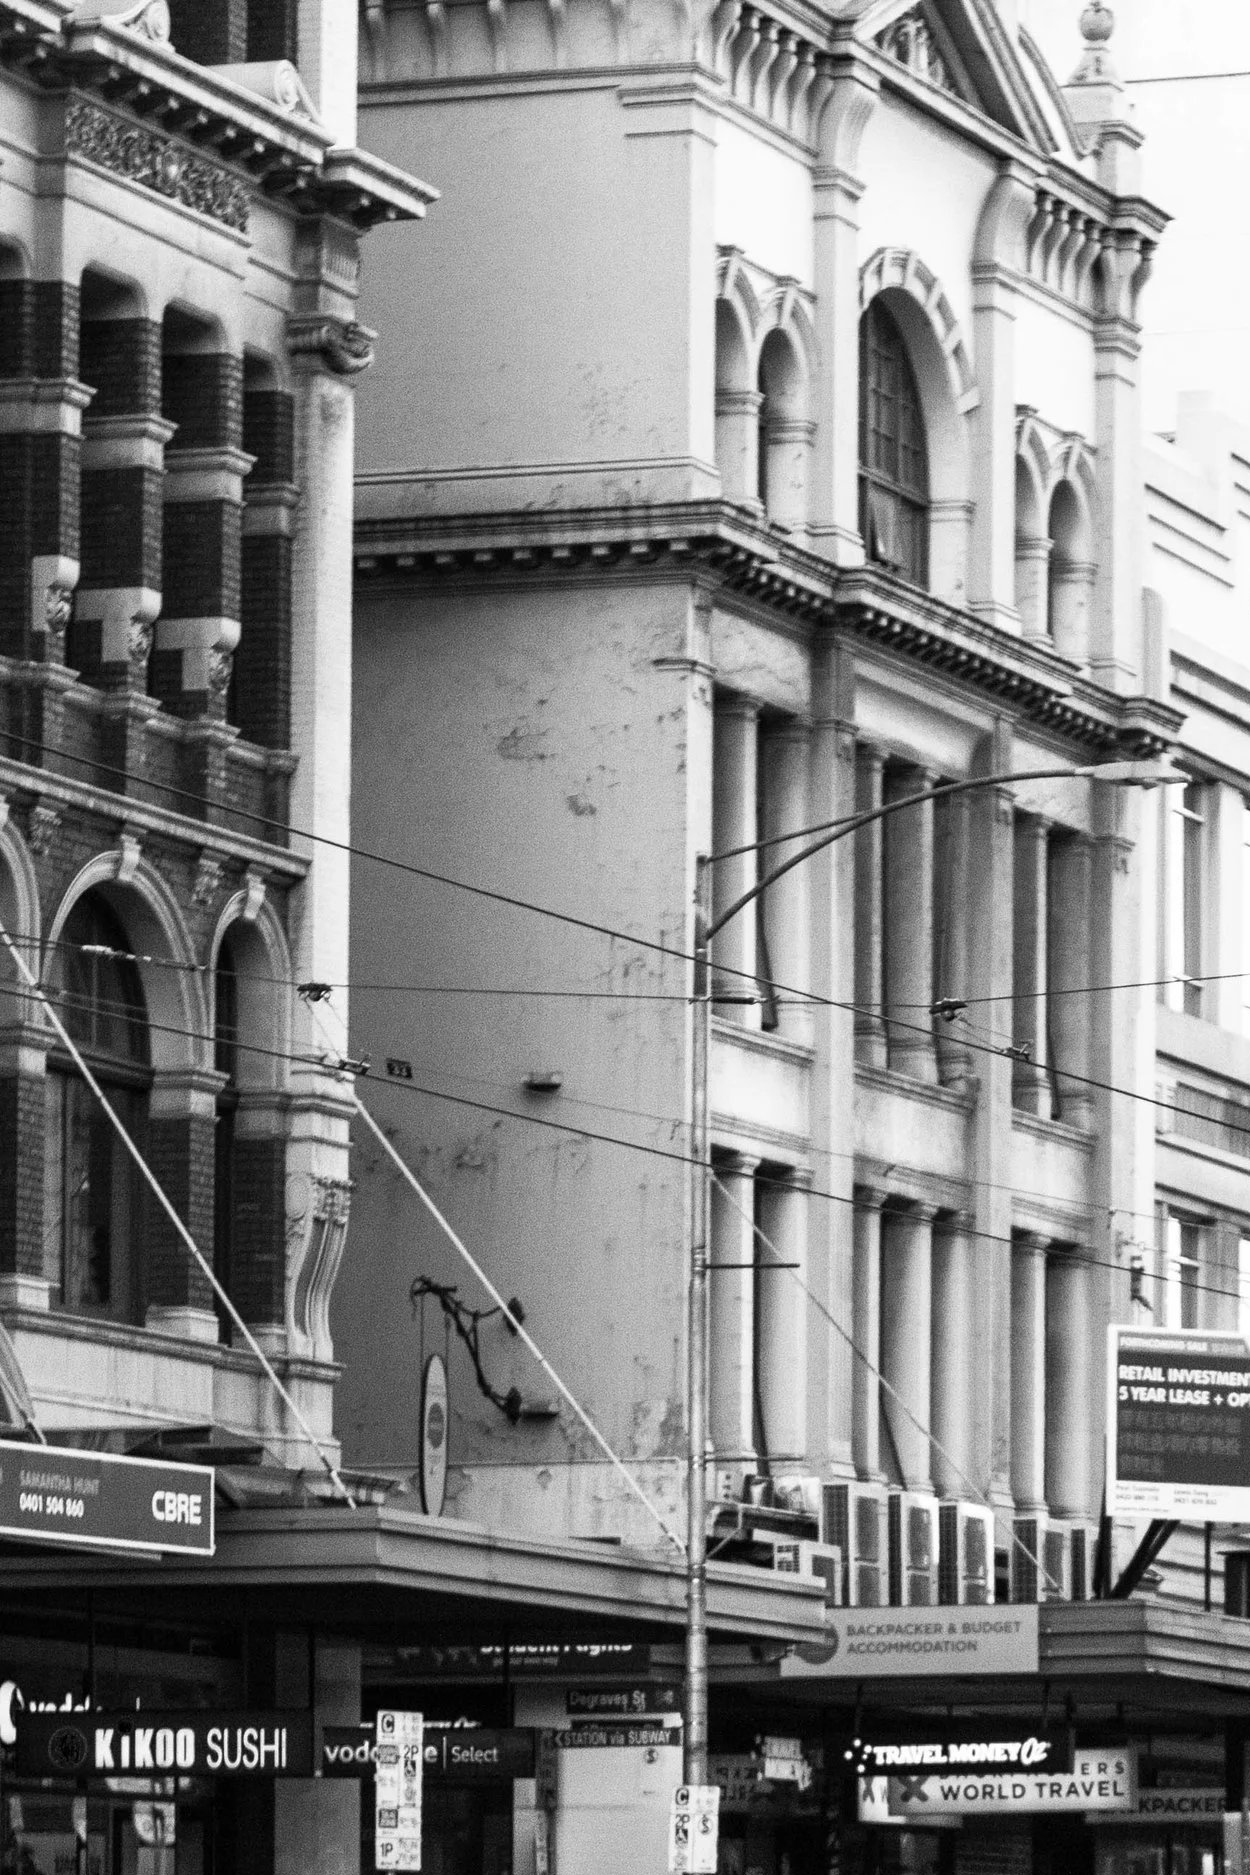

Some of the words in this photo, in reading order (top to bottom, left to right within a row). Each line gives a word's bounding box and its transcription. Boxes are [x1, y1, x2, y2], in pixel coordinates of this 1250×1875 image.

[1118, 1365, 1165, 1382] RETAIL
[1118, 1386, 1129, 1401] 5
[1130, 1386, 1166, 1403] YEAR
[1168, 1388, 1211, 1405] LEASE
[1214, 1394, 1224, 1406] +
[19, 1492, 43, 1513] 0401
[151, 1490, 202, 1525] CBRE
[847, 1622, 943, 1637] BACKPACKER
[948, 1623, 958, 1635] &
[962, 1621, 1021, 1634] BUDGET
[846, 1639, 978, 1655] ACCOMMODATION
[569, 1690, 628, 1709] Degraves
[632, 1689, 646, 1705] St
[206, 1726, 287, 1769] SUSHI
[563, 1731, 607, 1746] STATION
[610, 1731, 625, 1745] via
[628, 1730, 671, 1745] SUBWAY
[403, 1744, 419, 1760] 2P
[451, 1745, 499, 1764] Select
[873, 1743, 948, 1765] TRAVEL
[948, 1742, 1021, 1764] MONEY
[940, 1783, 1026, 1801] WORLD
[1035, 1780, 1125, 1798] TRAVEL
[380, 1842, 394, 1857] 1P
